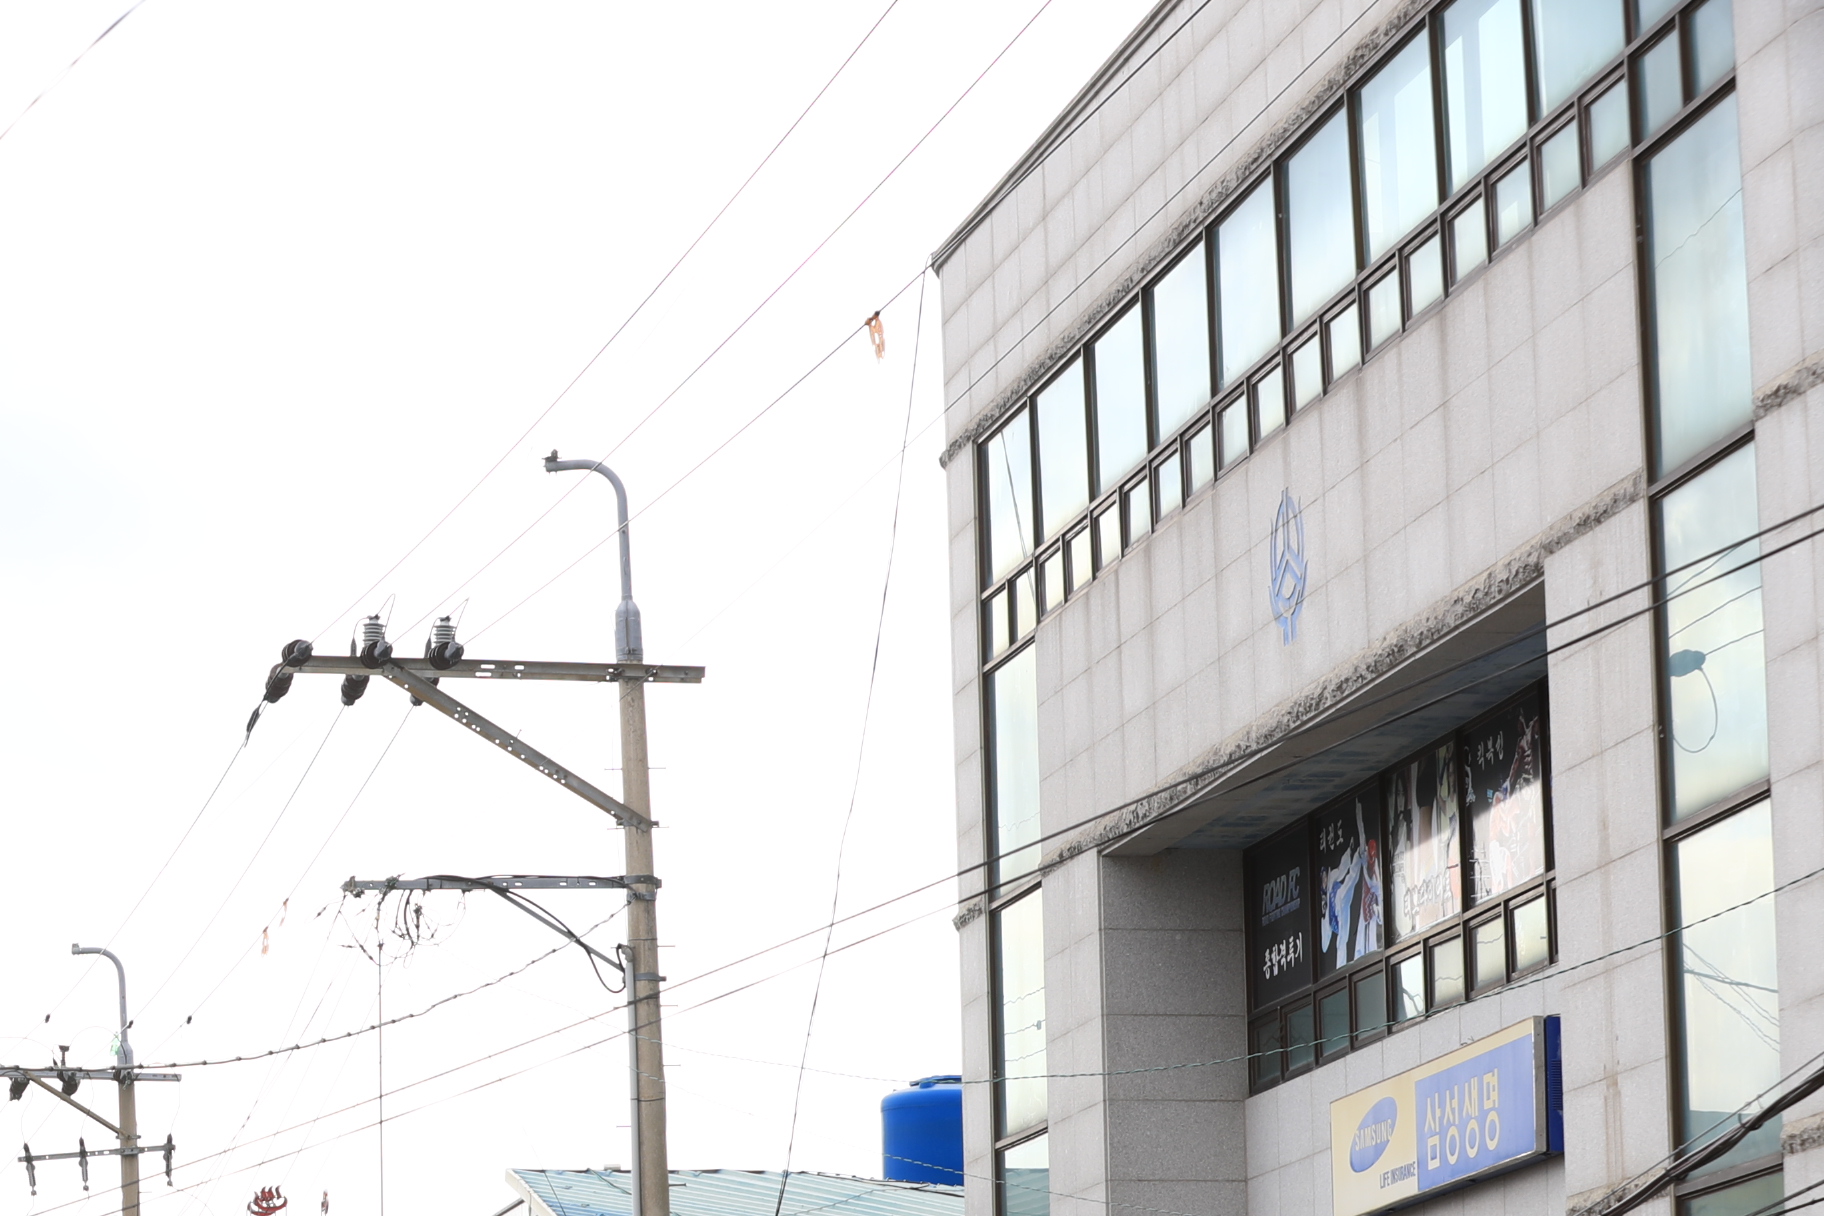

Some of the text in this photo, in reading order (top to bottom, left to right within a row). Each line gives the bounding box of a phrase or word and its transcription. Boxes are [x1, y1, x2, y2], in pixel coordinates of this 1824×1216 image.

[1262, 875, 1288, 916] ROAD
[1288, 866, 1301, 898] FC
[1354, 1118, 1392, 1152] SAMSUNG
[1424, 1067, 1500, 1171] 삼성생명
[1379, 1161, 1416, 1189] LIFE INSURANCE
